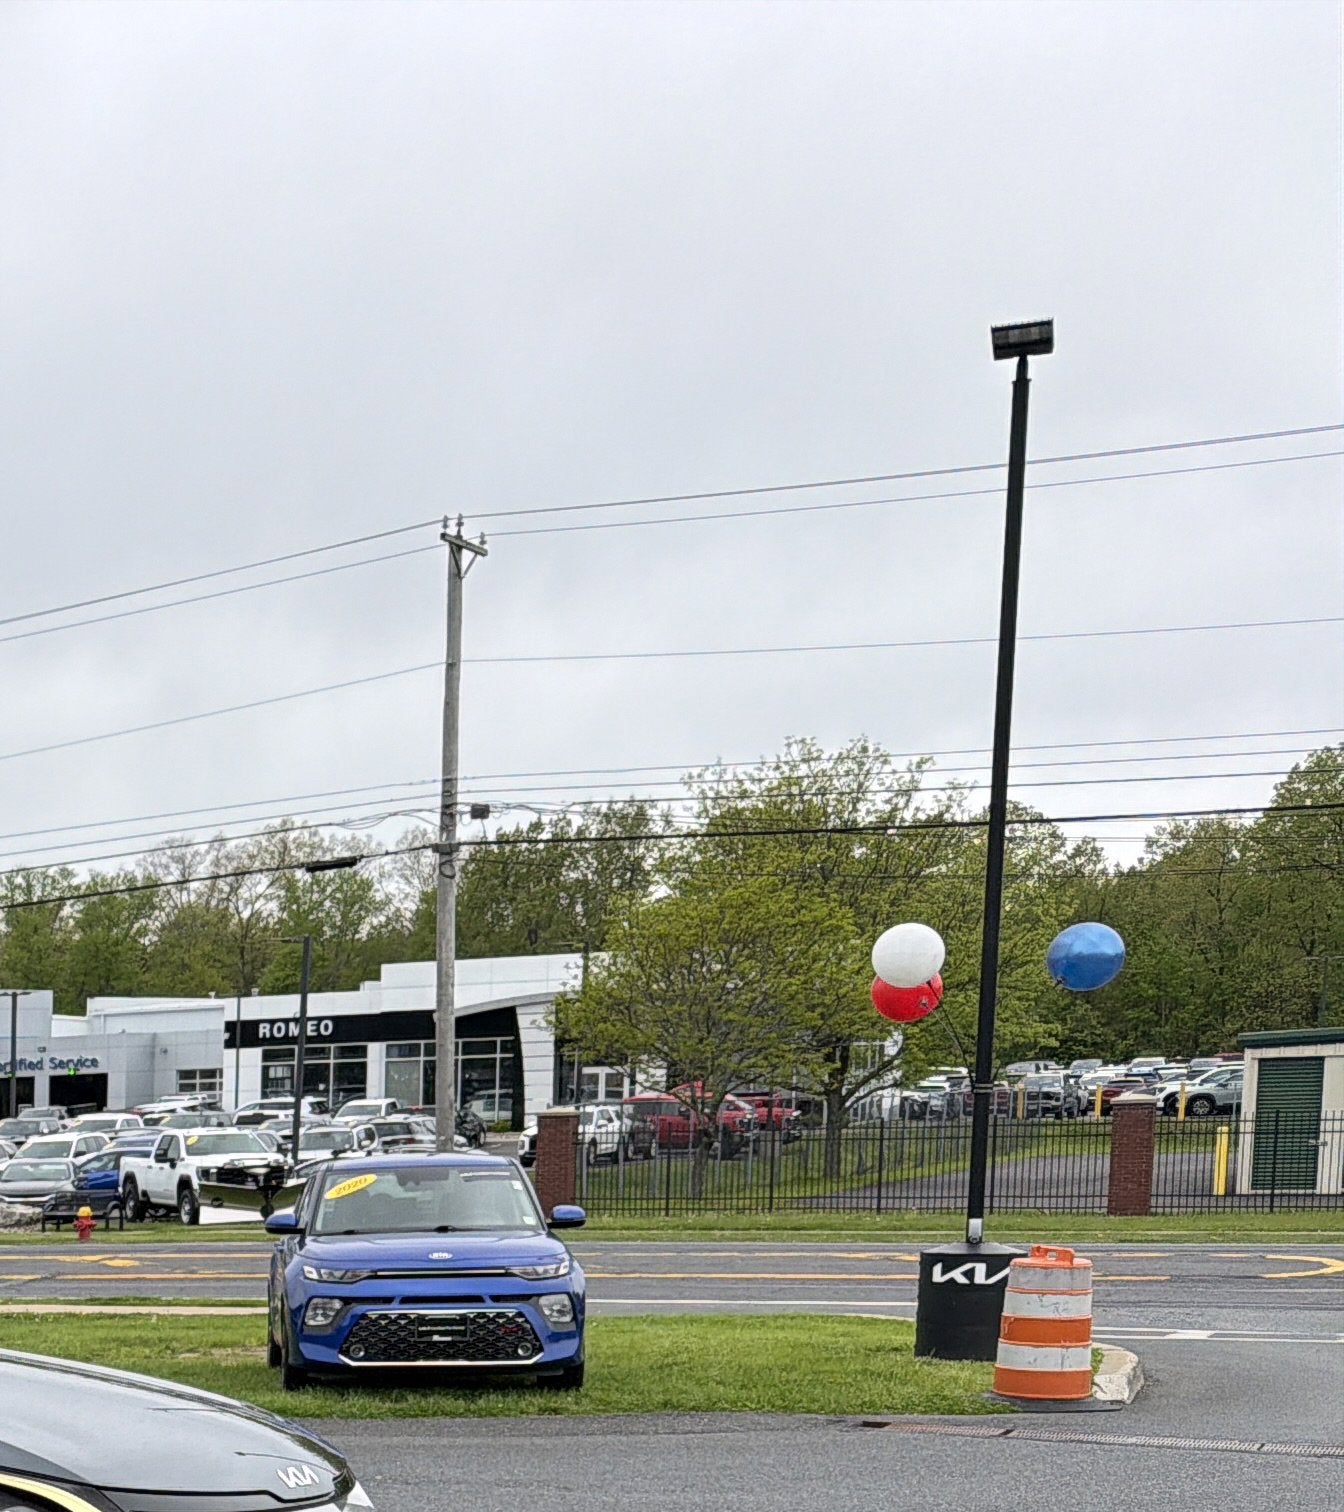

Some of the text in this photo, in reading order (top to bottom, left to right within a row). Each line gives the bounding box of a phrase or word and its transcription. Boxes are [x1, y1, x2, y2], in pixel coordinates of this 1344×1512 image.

[258, 1020, 333, 1039] ROMEO
[49, 1056, 99, 1070] Service
[276, 1464, 320, 1488] KIA
